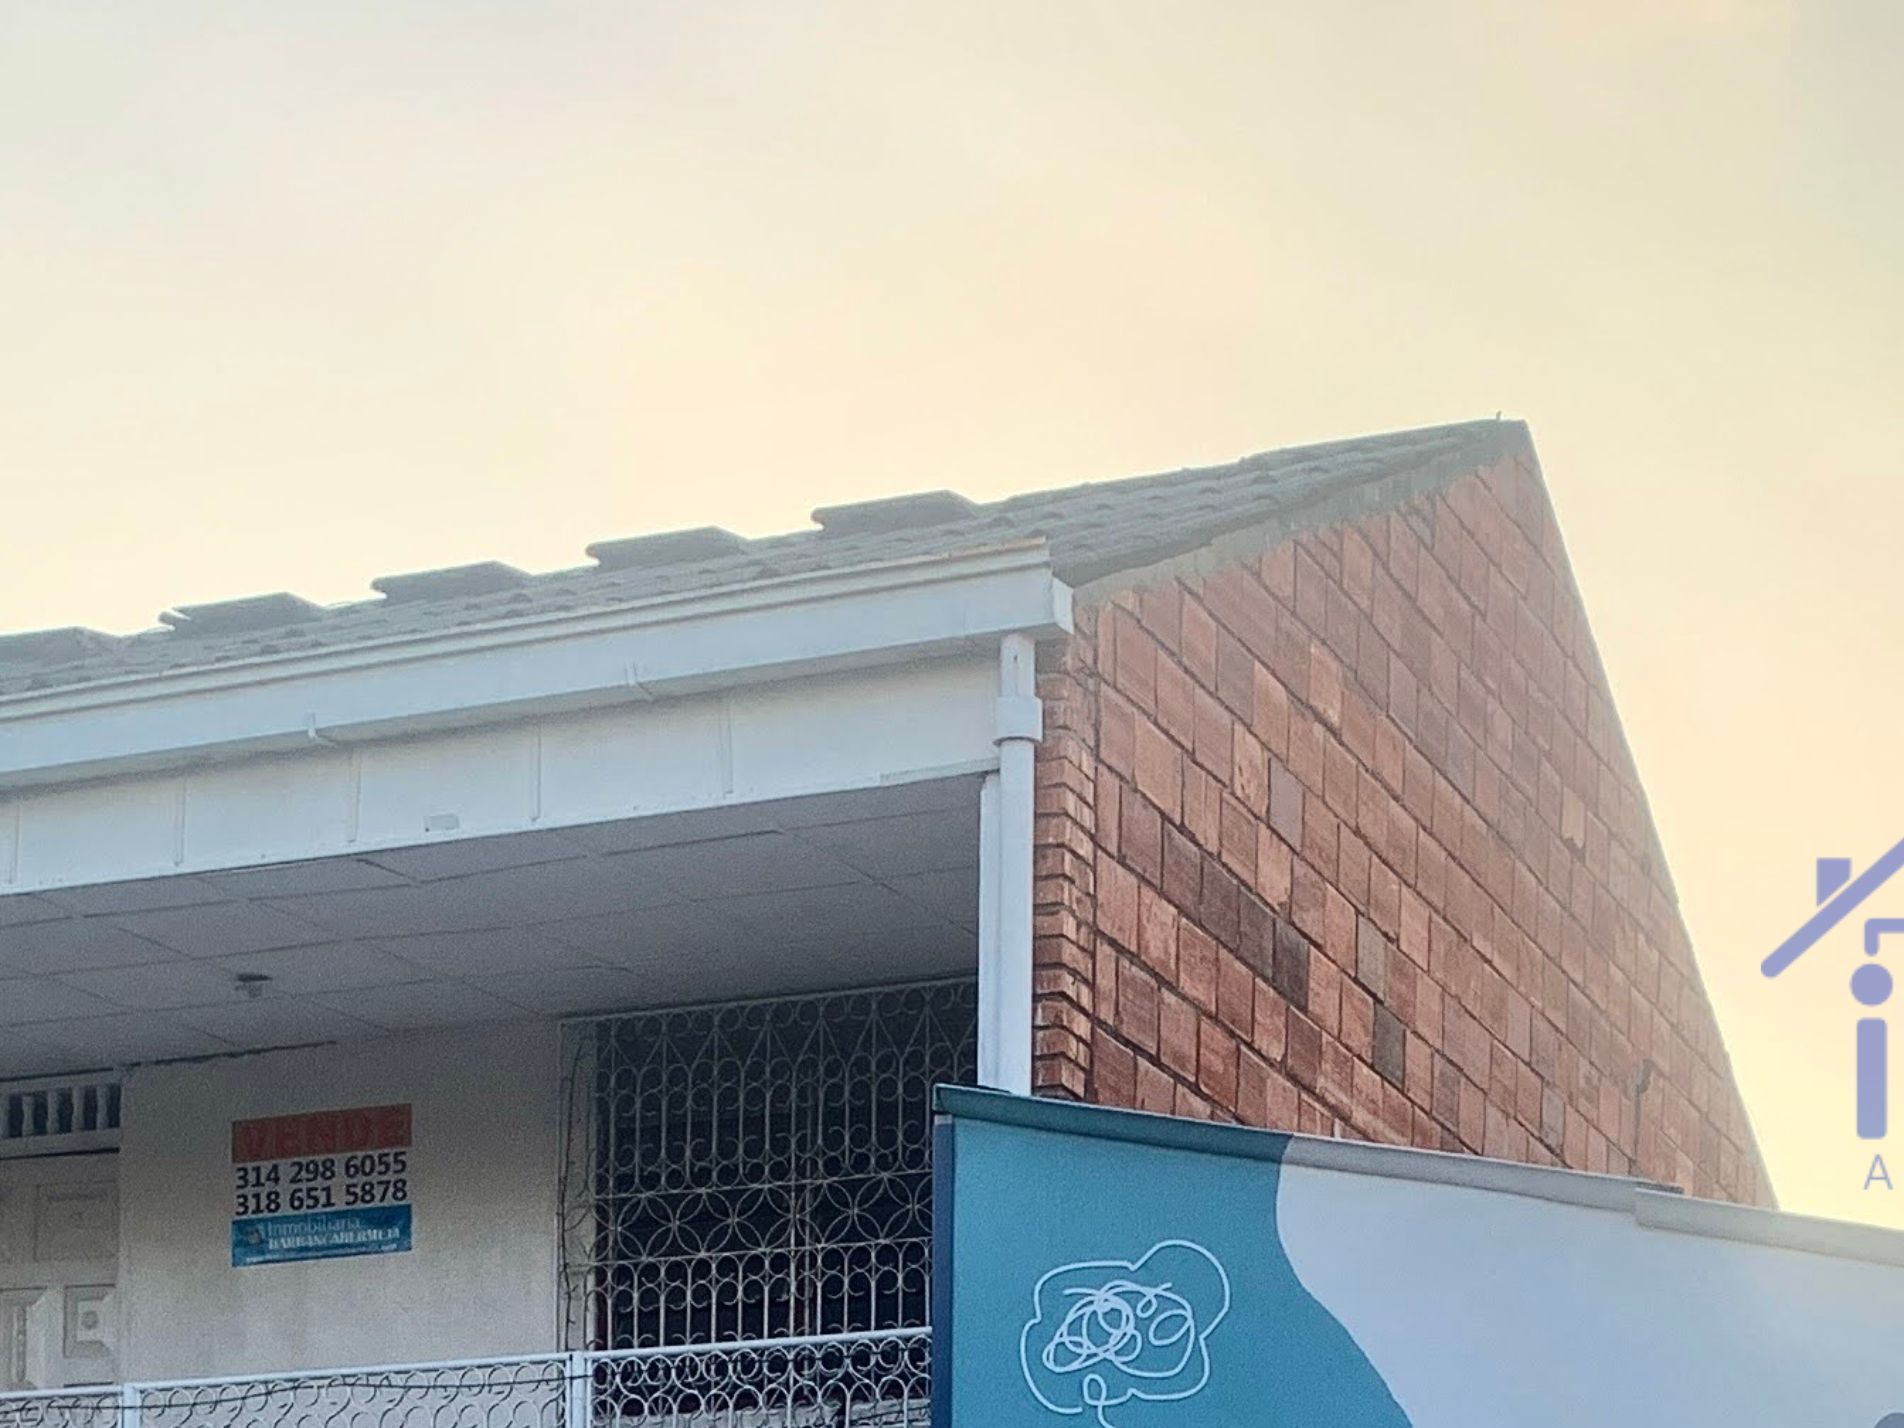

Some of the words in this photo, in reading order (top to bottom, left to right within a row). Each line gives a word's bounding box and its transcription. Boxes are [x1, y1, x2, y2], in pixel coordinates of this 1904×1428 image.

[235, 1164, 281, 1190] 314
[289, 1157, 336, 1184] 298
[345, 1150, 408, 1178] 6055
[235, 1190, 281, 1216] 318
[288, 1185, 336, 1211] 651
[345, 1178, 408, 1206] 5878
